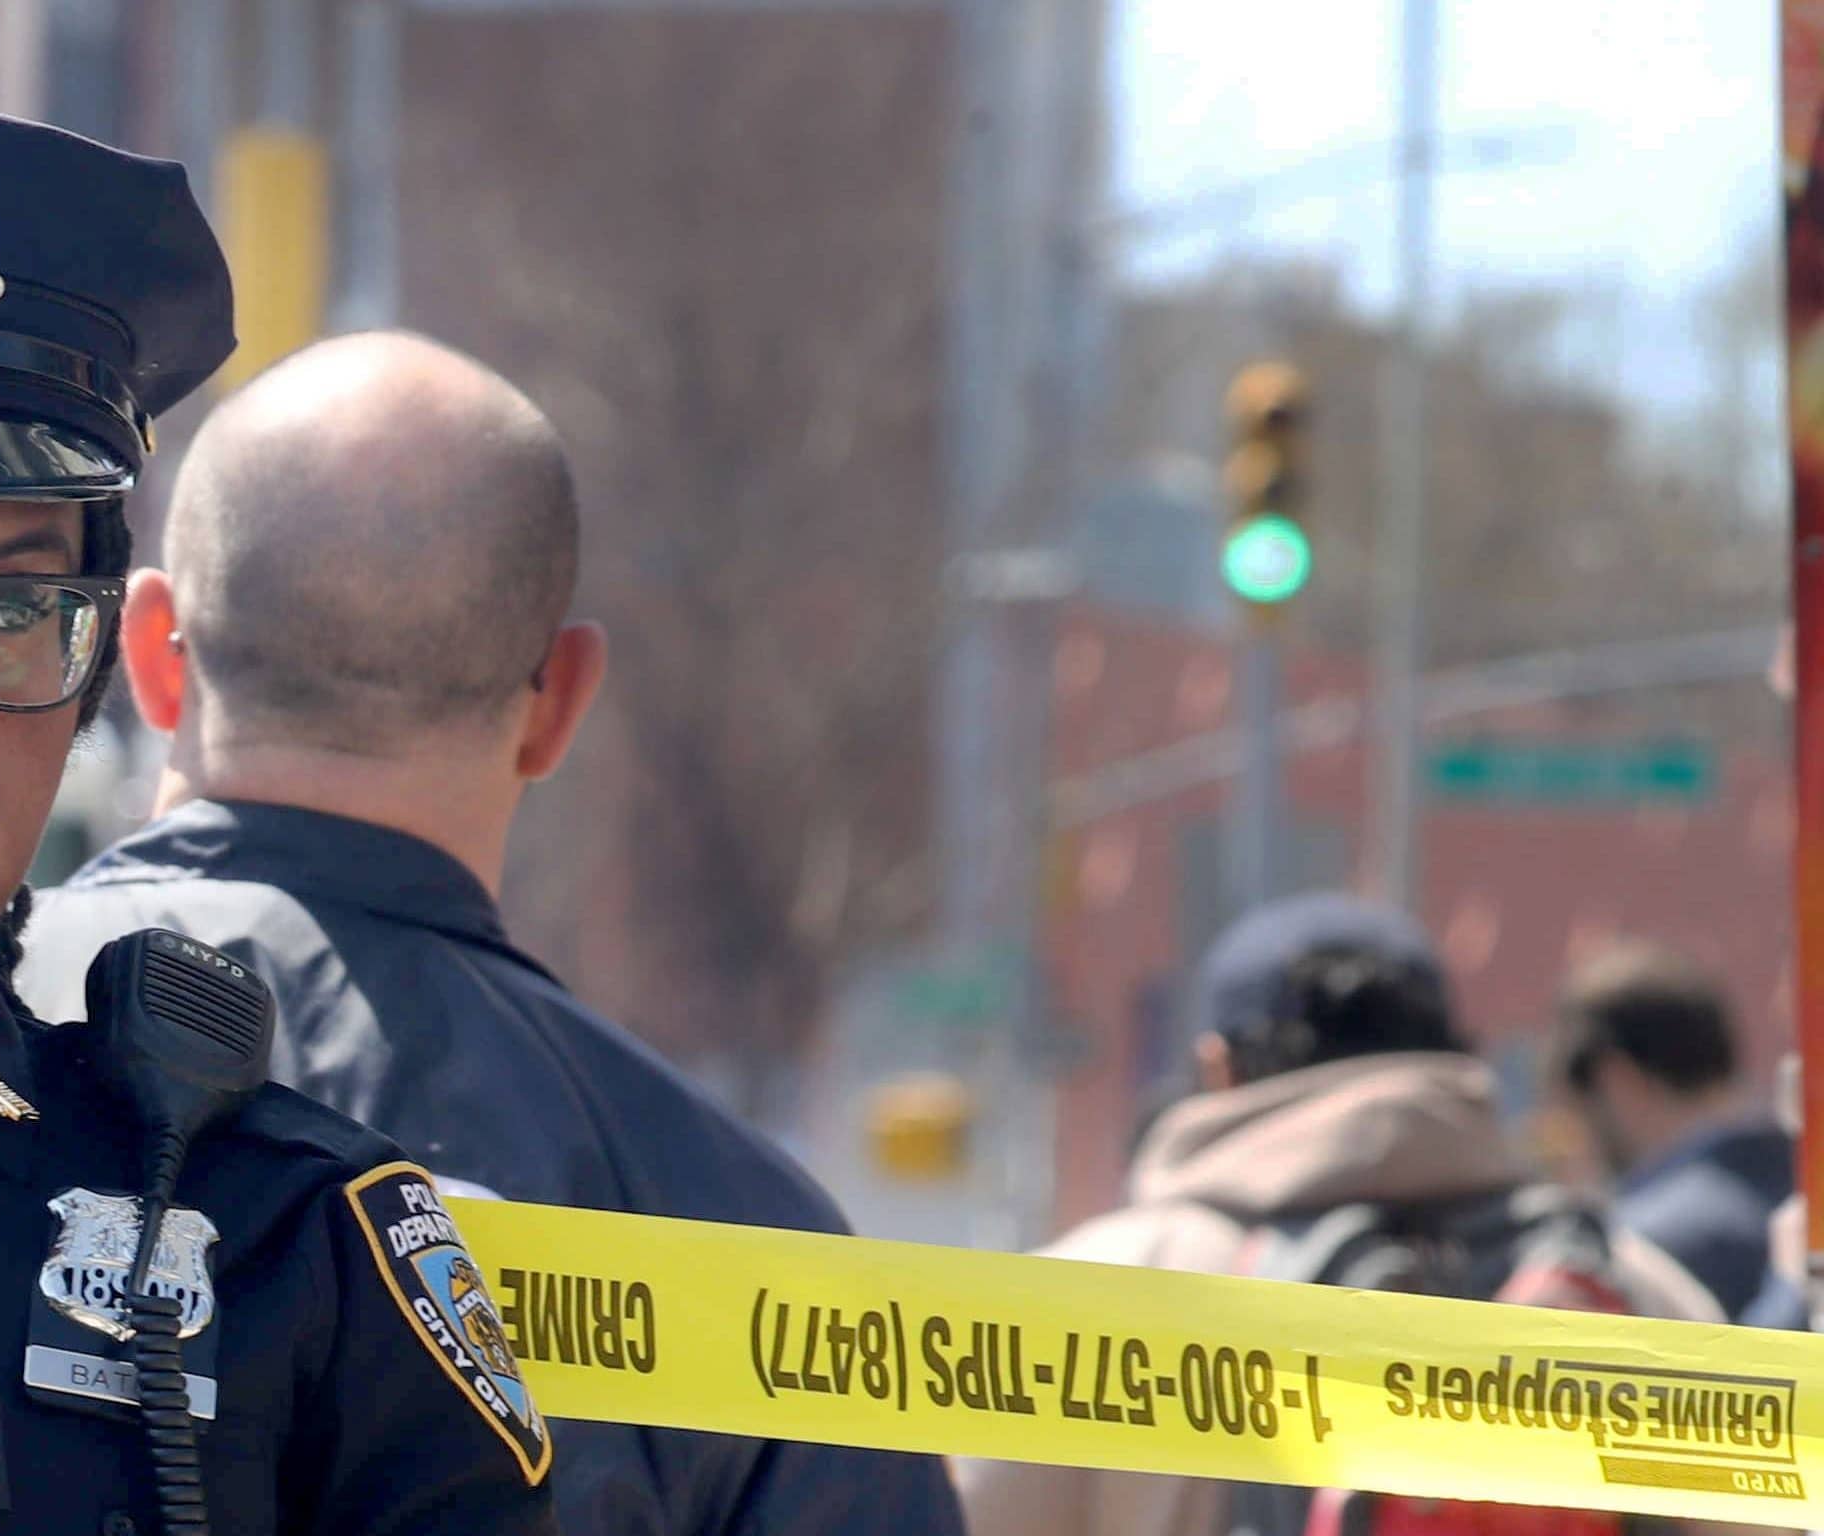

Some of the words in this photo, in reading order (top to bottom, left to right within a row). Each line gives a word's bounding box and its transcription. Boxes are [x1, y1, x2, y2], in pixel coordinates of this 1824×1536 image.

[182, 942, 245, 978] NYPD
[412, 1296, 474, 1369] CITY
[473, 1375, 510, 1419] OF
[499, 1267, 656, 1375] CRIME
[751, 1288, 909, 1412] (8477)
[70, 1363, 139, 1395] BAT
[920, 1315, 1334, 1443] 1-800-577-TIPS
[1731, 1469, 1800, 1496] NYPD
